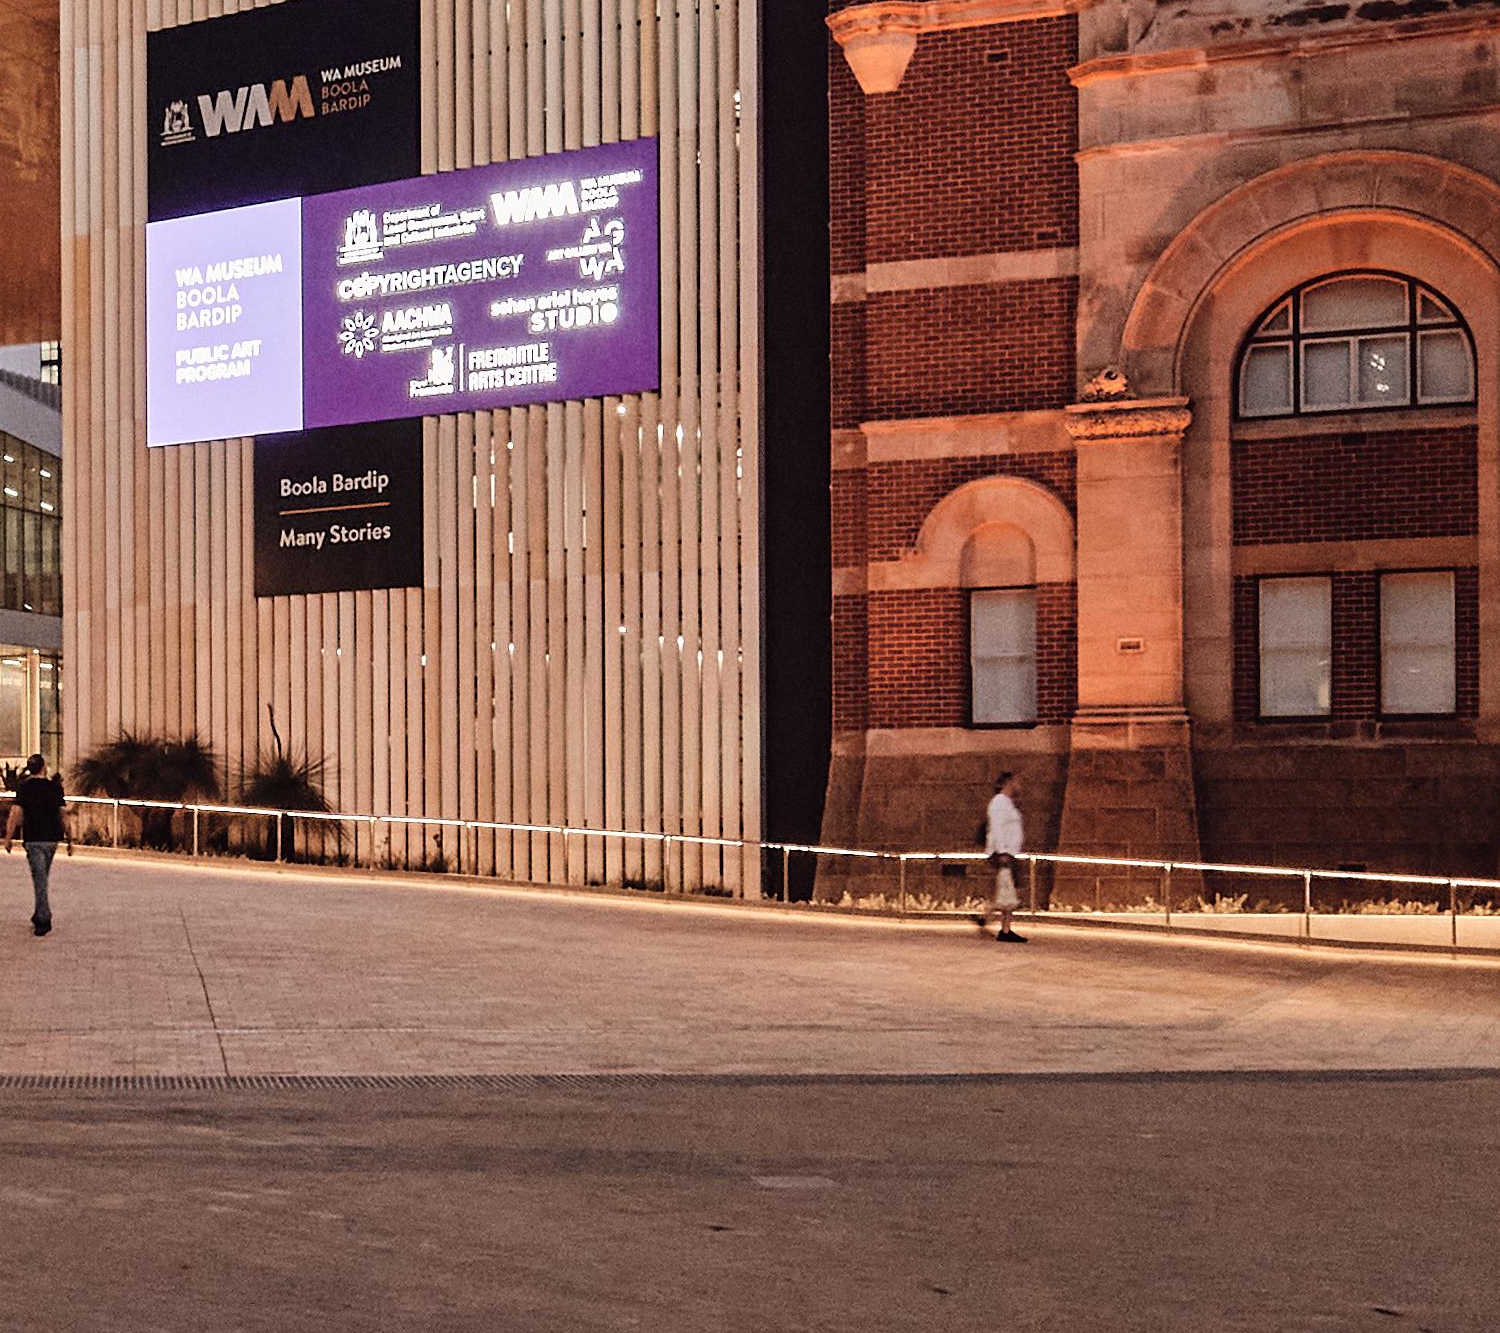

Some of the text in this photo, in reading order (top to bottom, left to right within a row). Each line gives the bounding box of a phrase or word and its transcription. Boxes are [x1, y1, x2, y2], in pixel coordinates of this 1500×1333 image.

[321, 55, 402, 83] WA MUSEUM
[321, 79, 369, 99] BOOLA
[197, 75, 315, 137] WAM
[321, 94, 371, 115] BARDIP
[175, 254, 283, 287] WA MUSEUM
[176, 283, 239, 309] BOOLA
[176, 304, 242, 331] BARDIP
[530, 303, 618, 332] STUDIO
[175, 340, 261, 366] PUBLIC ART
[469, 342, 549, 370] FREMANTLE
[175, 359, 250, 384] PROGRAM
[469, 370, 505, 391] ARTS
[506, 363, 557, 389] CENTRE
[280, 470, 389, 497] Boola Bardip
[280, 523, 391, 550] Many Stories
